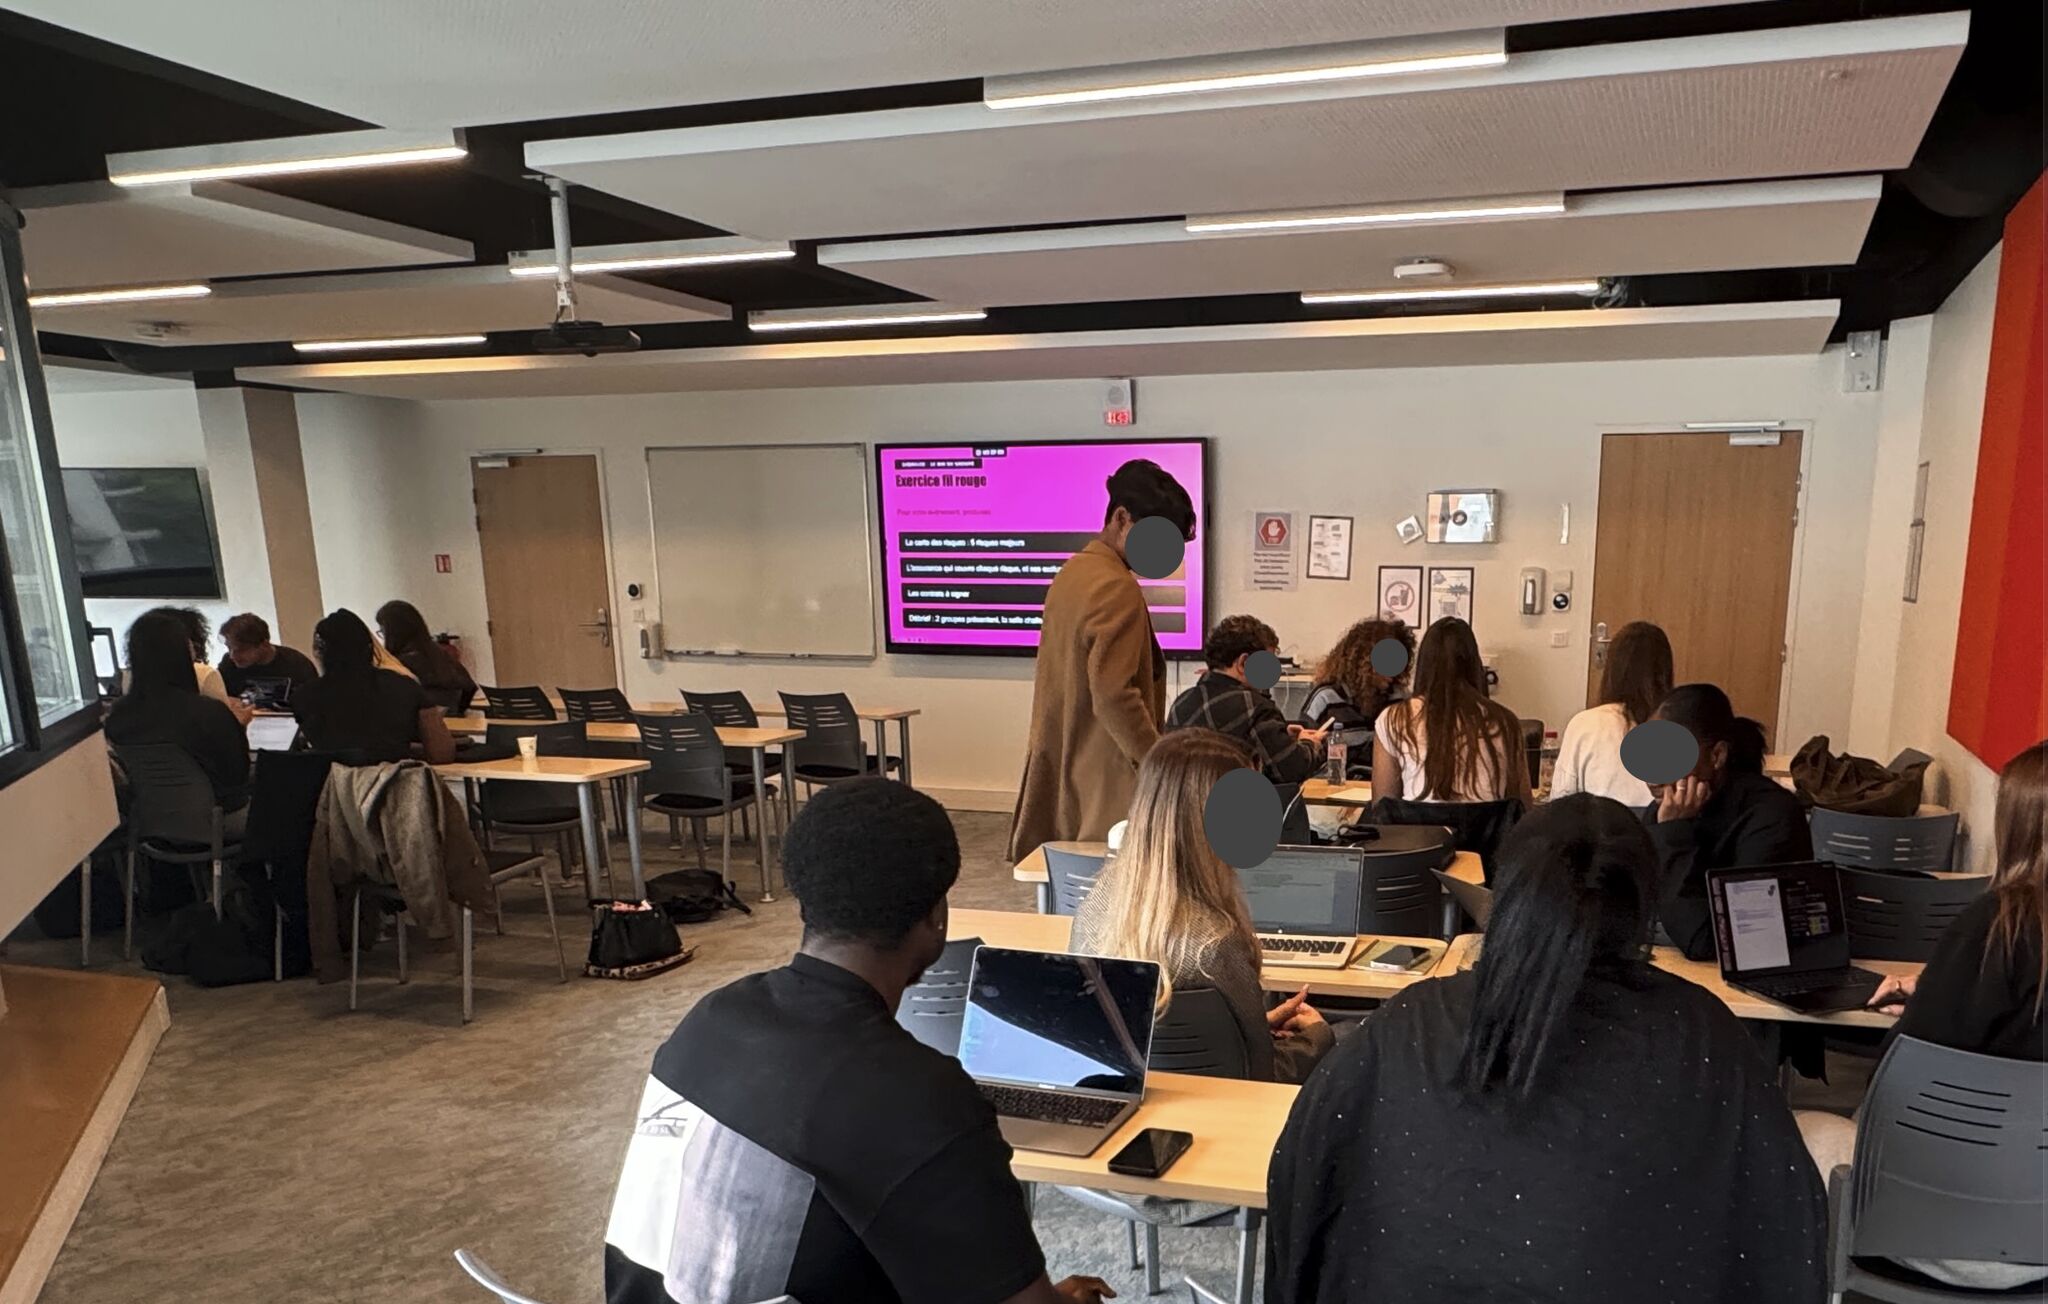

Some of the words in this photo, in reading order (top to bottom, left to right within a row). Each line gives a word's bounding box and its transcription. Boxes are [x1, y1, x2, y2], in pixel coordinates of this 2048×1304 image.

[896, 474, 940, 487] Exercice
[942, 474, 953, 487] fil
[955, 475, 987, 488] rouge
